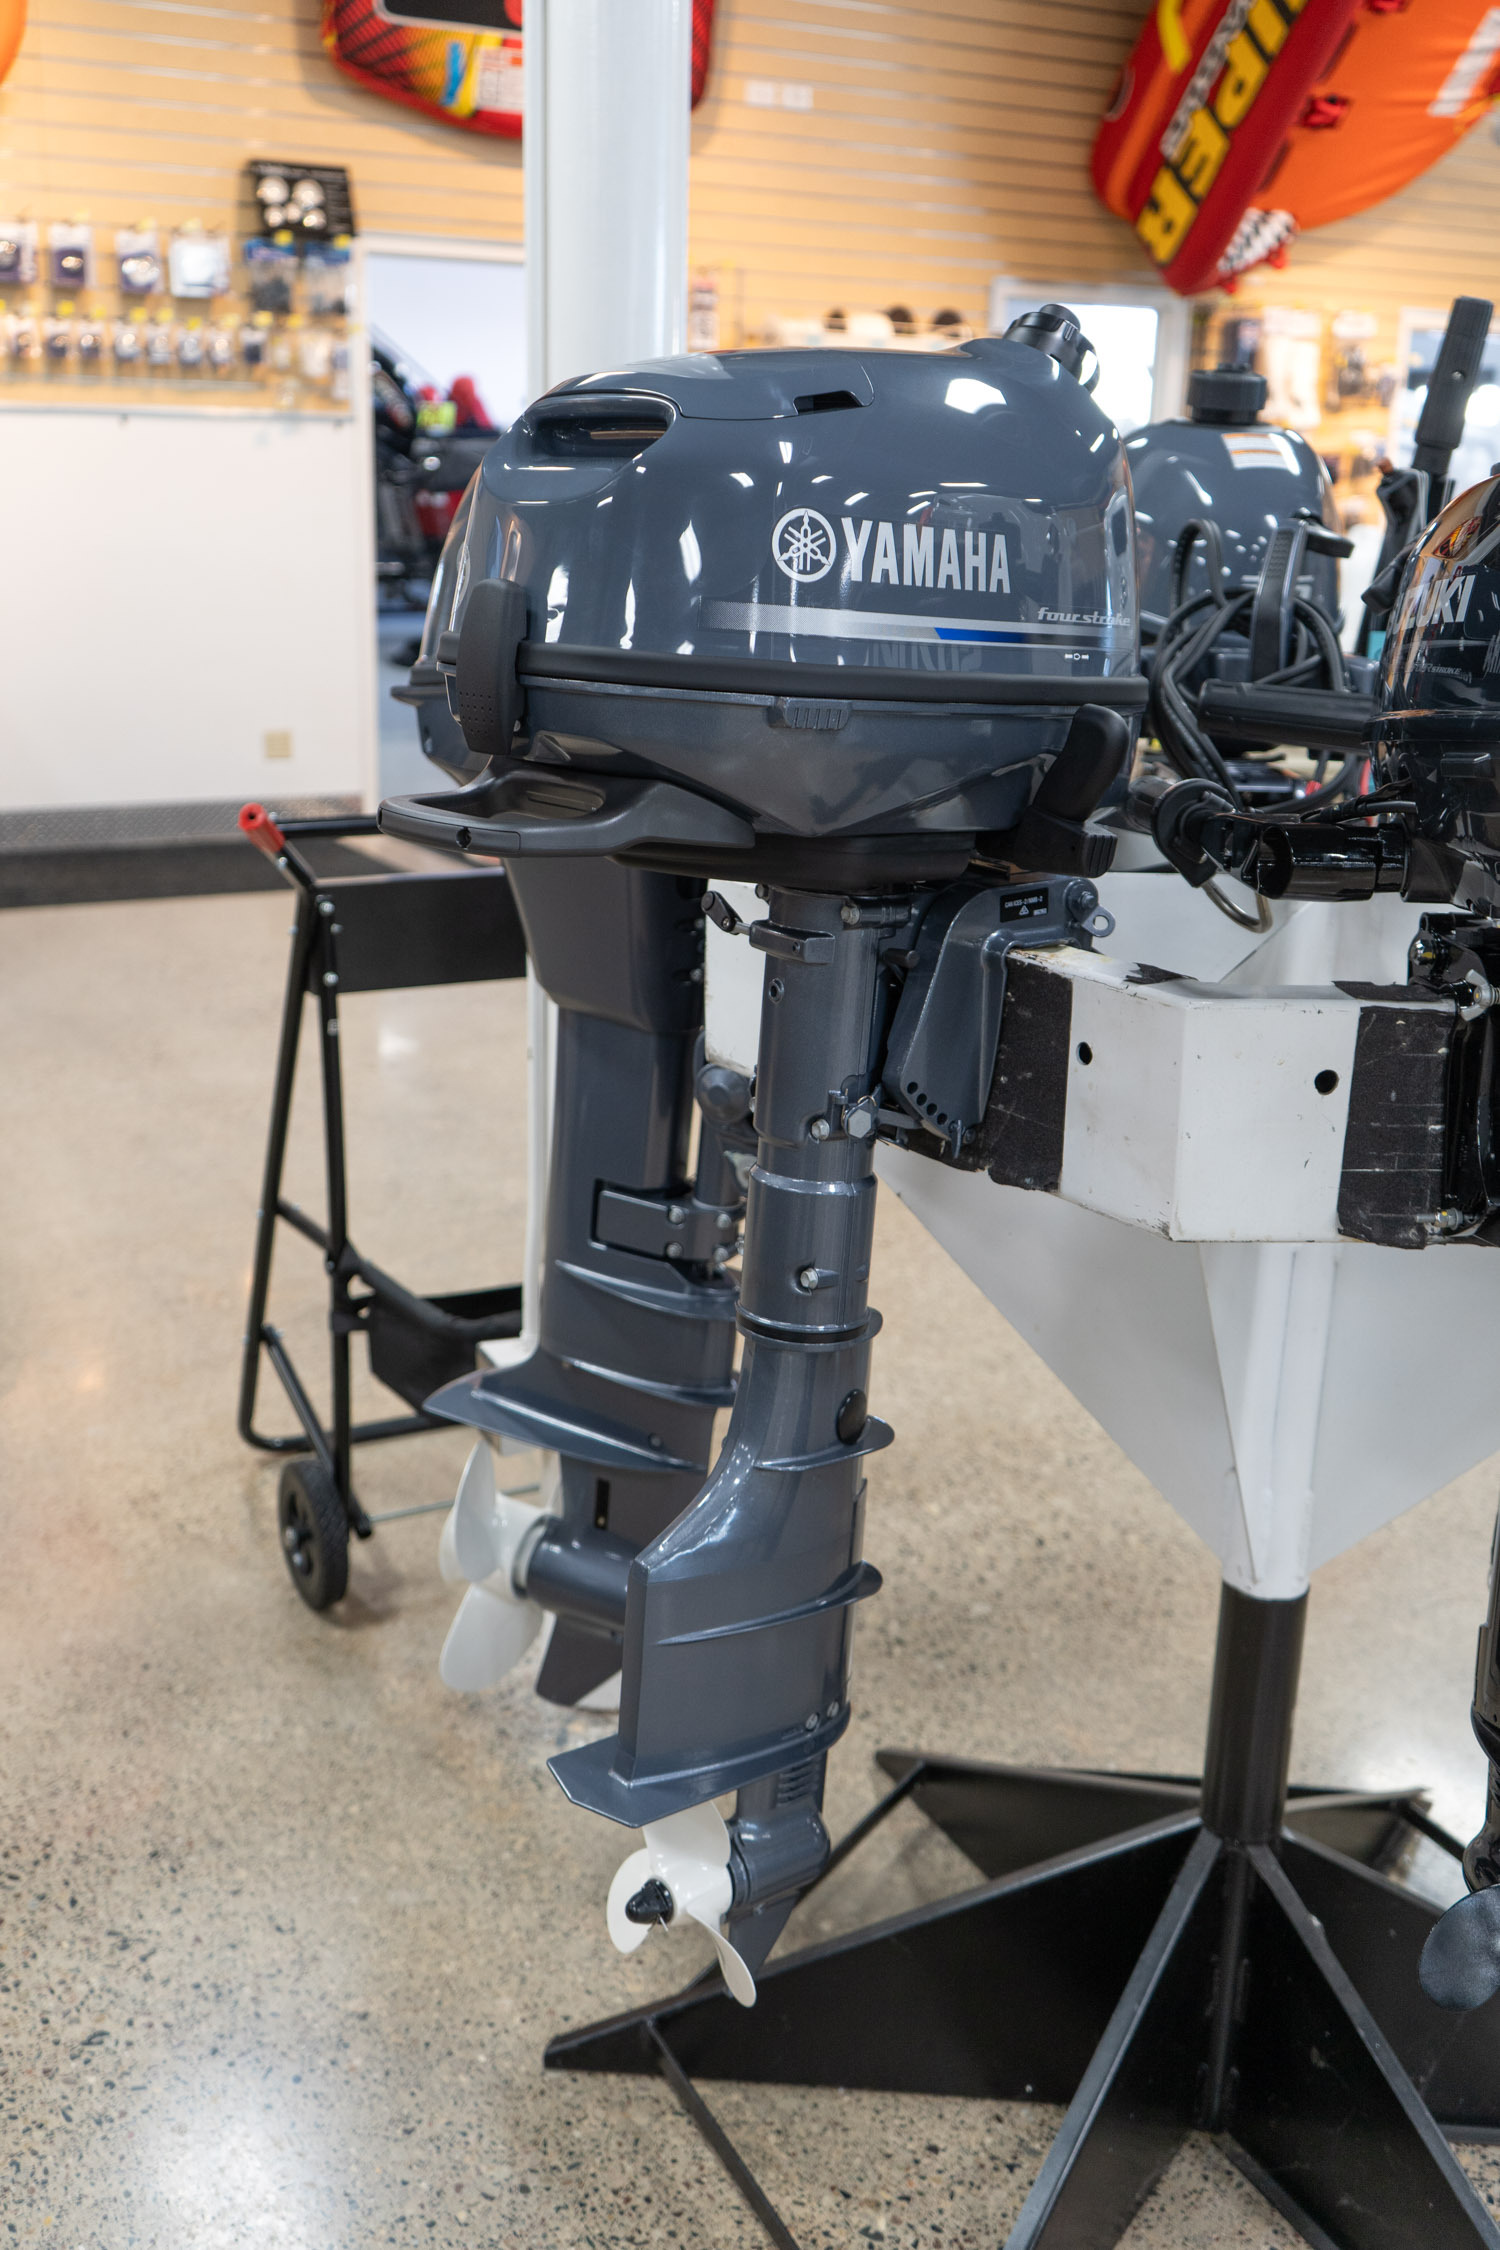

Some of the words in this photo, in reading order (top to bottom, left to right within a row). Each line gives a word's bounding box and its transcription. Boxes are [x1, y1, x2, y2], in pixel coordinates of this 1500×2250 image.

[1136, 0, 1308, 264] IPER
[841, 517, 1011, 594] YAMAHA
[1386, 575, 1476, 637] UZUKI
